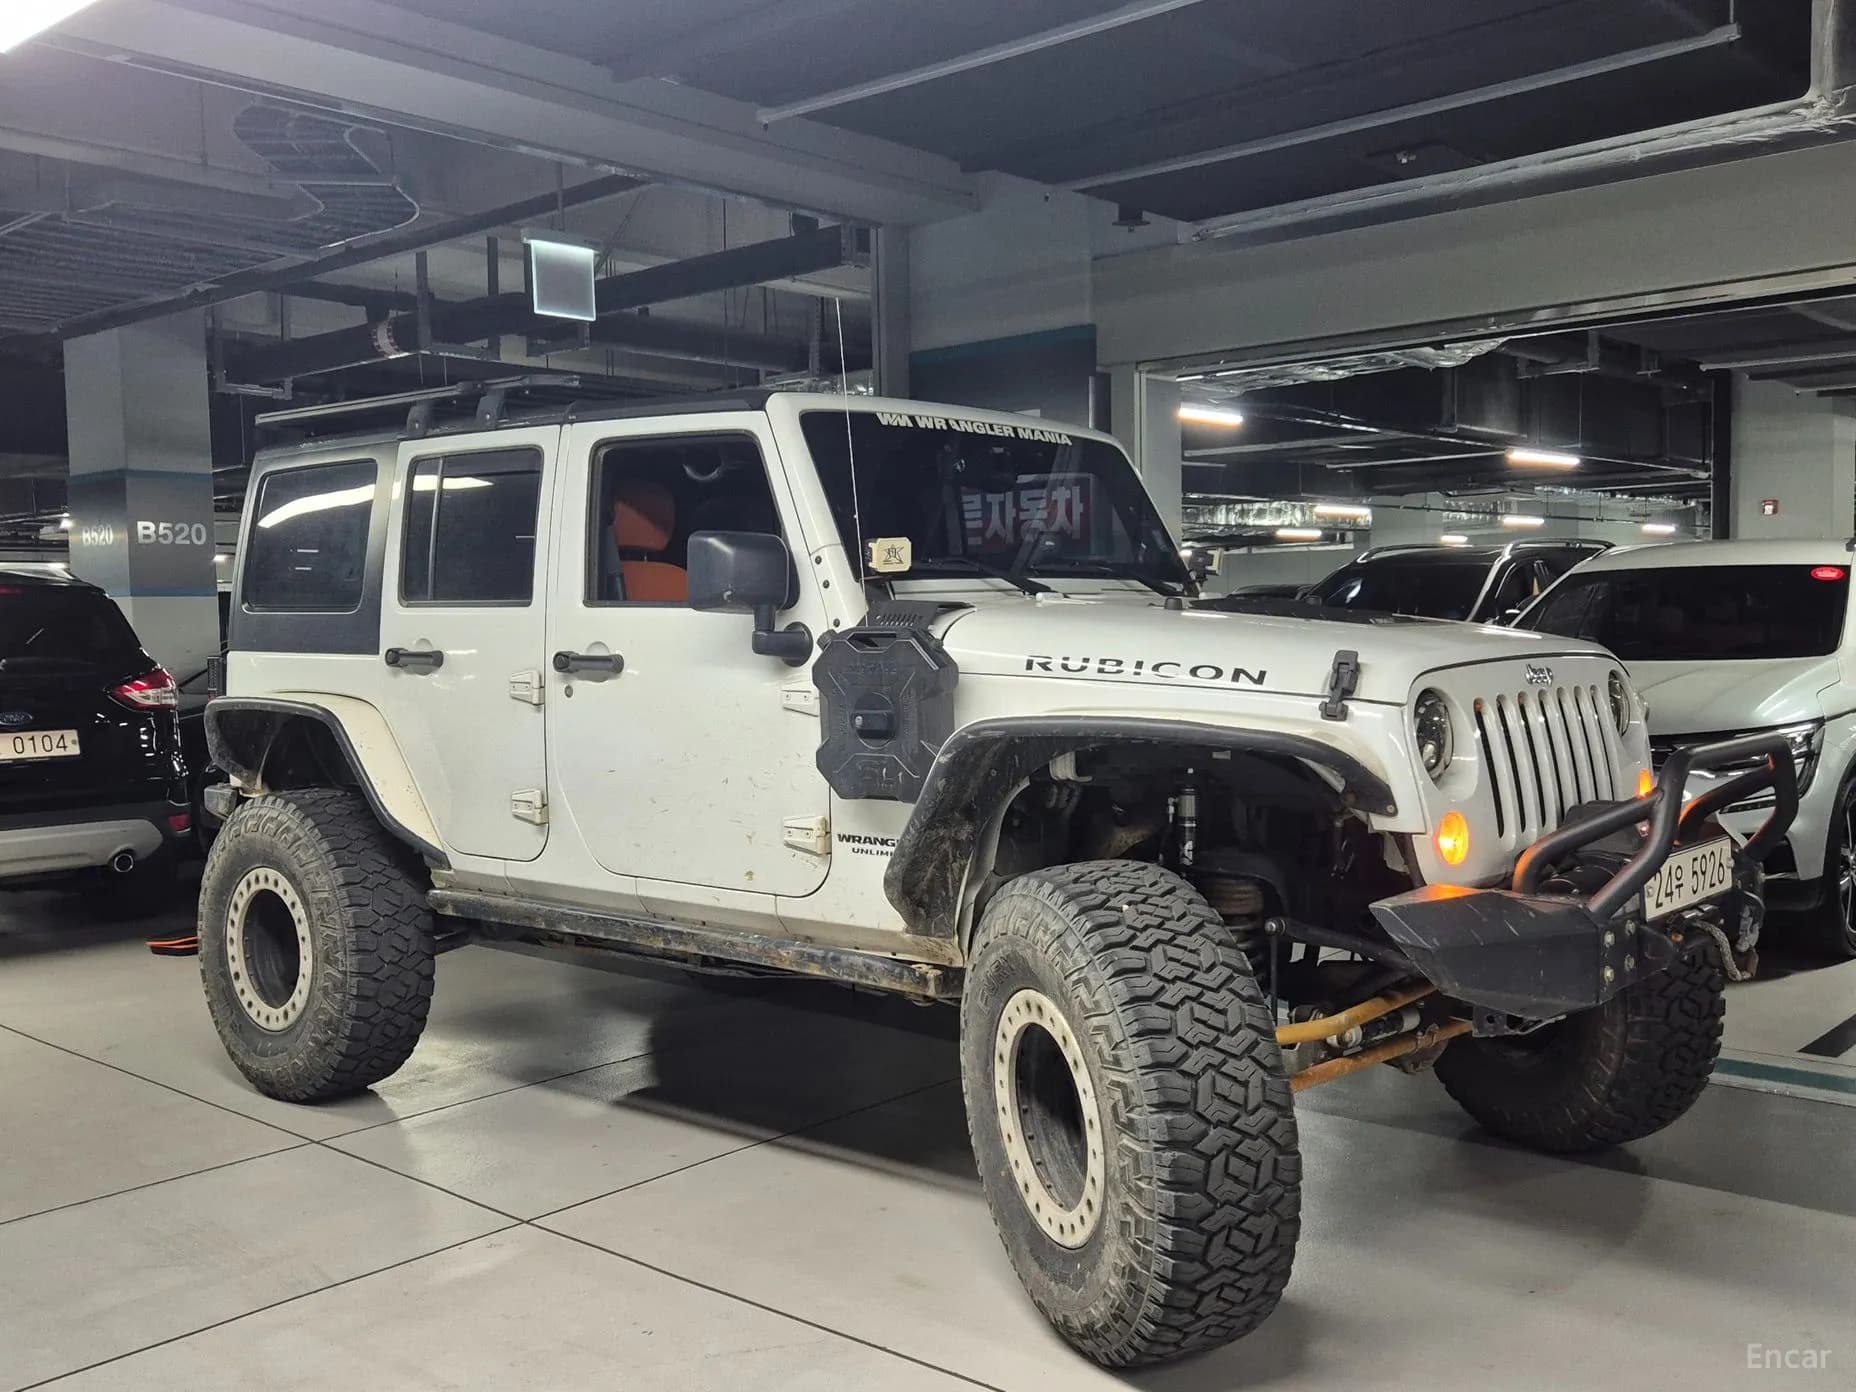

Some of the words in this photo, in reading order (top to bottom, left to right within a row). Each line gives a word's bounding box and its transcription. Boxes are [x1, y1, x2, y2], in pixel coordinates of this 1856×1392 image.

[915, 415, 1016, 438] WRANGLER
[1017, 427, 1073, 446] MANIA
[82, 524, 113, 547] B520
[137, 520, 207, 545] B520
[1025, 655, 1267, 686] RUBICON
[13, 734, 68, 754] 0104
[837, 833, 899, 847] WRANG
[1655, 864, 1684, 909] 24우
[1691, 847, 1725, 895] 5926
